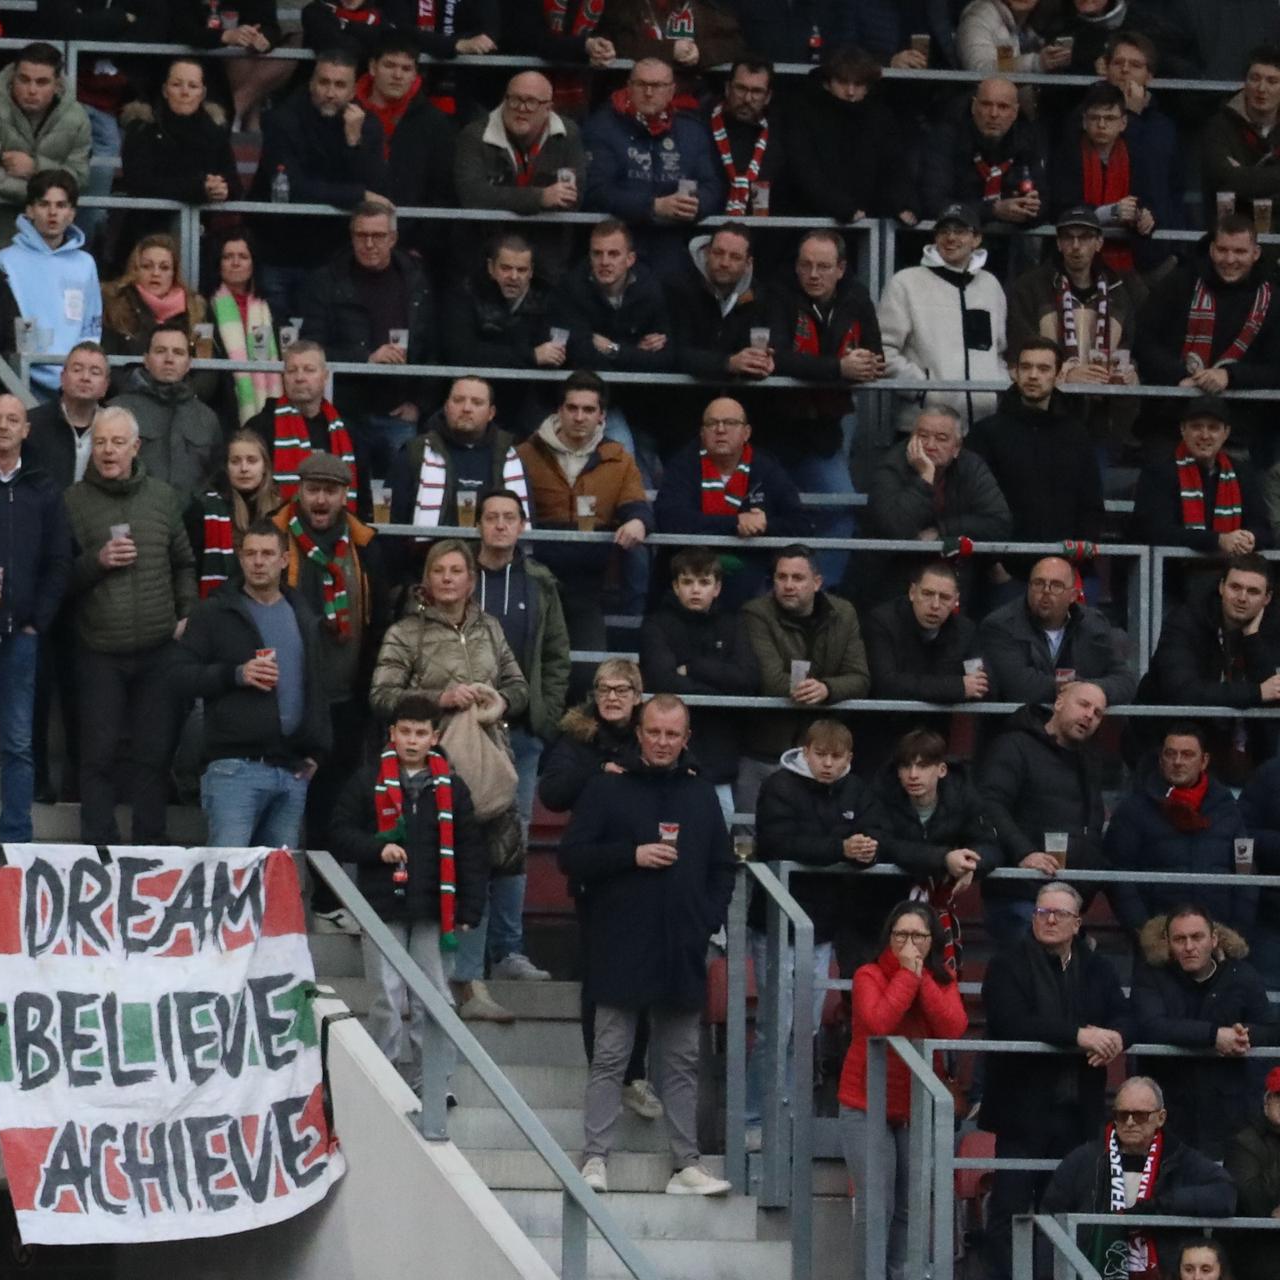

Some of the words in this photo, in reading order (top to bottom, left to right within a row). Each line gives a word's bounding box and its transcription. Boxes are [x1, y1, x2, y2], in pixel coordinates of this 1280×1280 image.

[24, 857, 265, 959] DREAM
[13, 973, 299, 1091] BELIEVE
[40, 1096, 328, 1217] ACHIEVE
